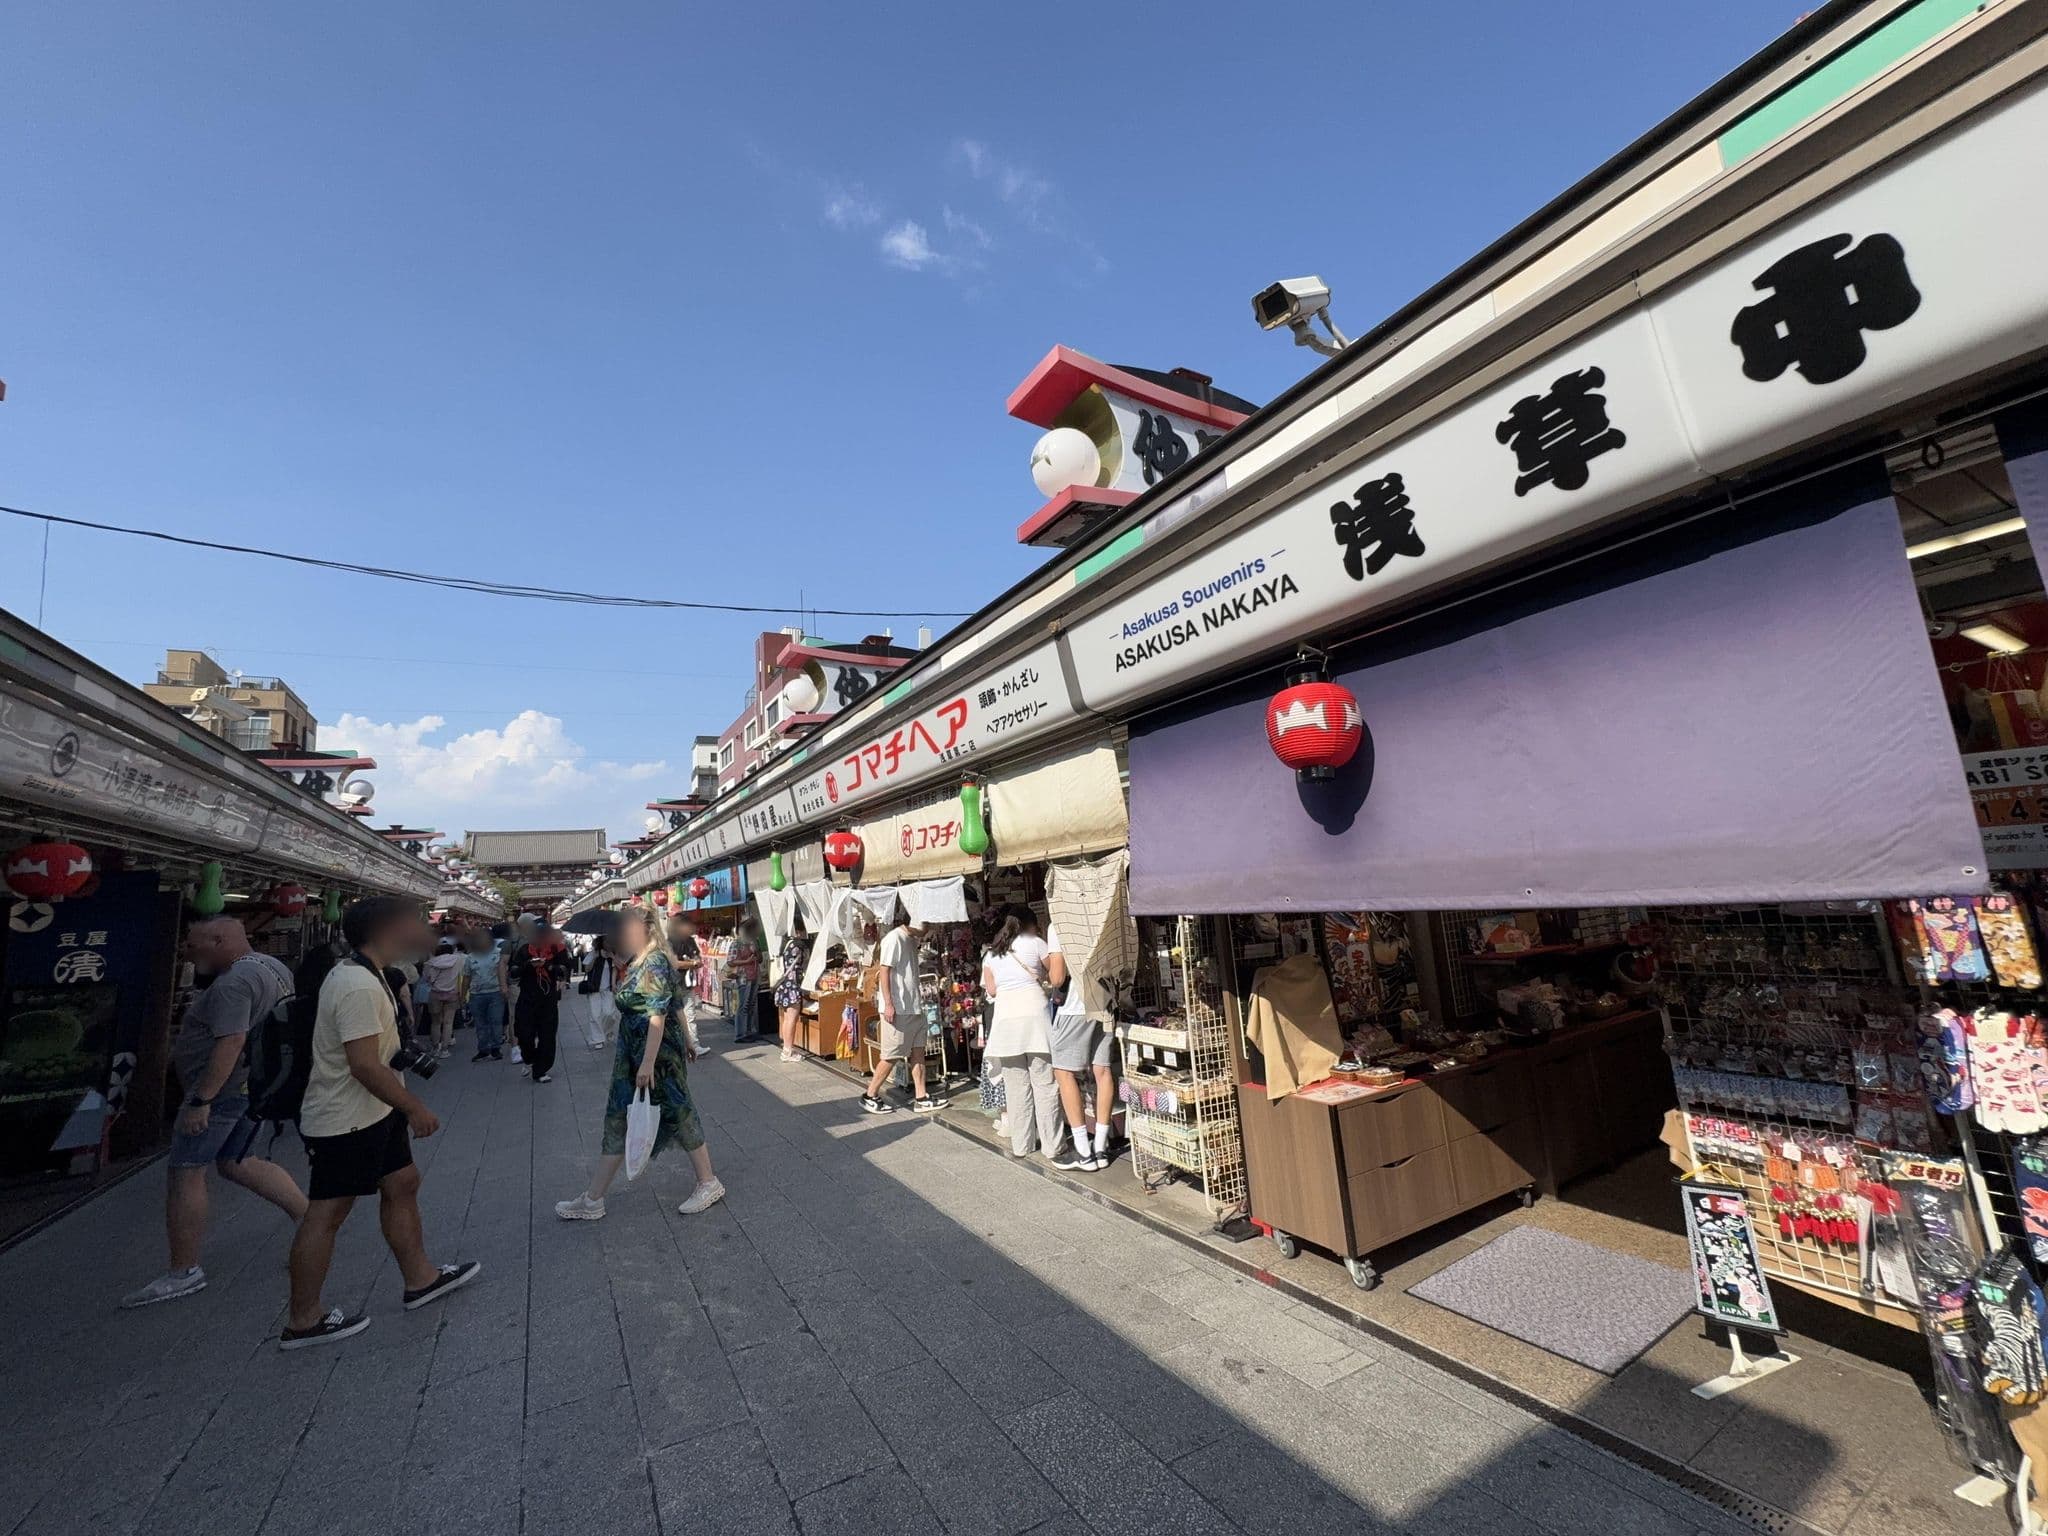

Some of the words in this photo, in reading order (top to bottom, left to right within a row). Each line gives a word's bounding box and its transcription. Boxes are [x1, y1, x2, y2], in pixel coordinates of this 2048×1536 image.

[1122, 601, 1180, 640] Asakusa
[1181, 558, 1266, 609] Souvenirs
[1115, 619, 1200, 673] ASAKUSA
[1201, 573, 1300, 633] NAKAYA
[986, 701, 1048, 734] ヘアアクセサリー
[844, 697, 968, 792] コマチヘア
[1966, 769, 2010, 786] ABI
[57, 930, 108, 948] 豆屋
[54, 950, 106, 984] 清
[1908, 1164, 1961, 1183] 忍者刀
